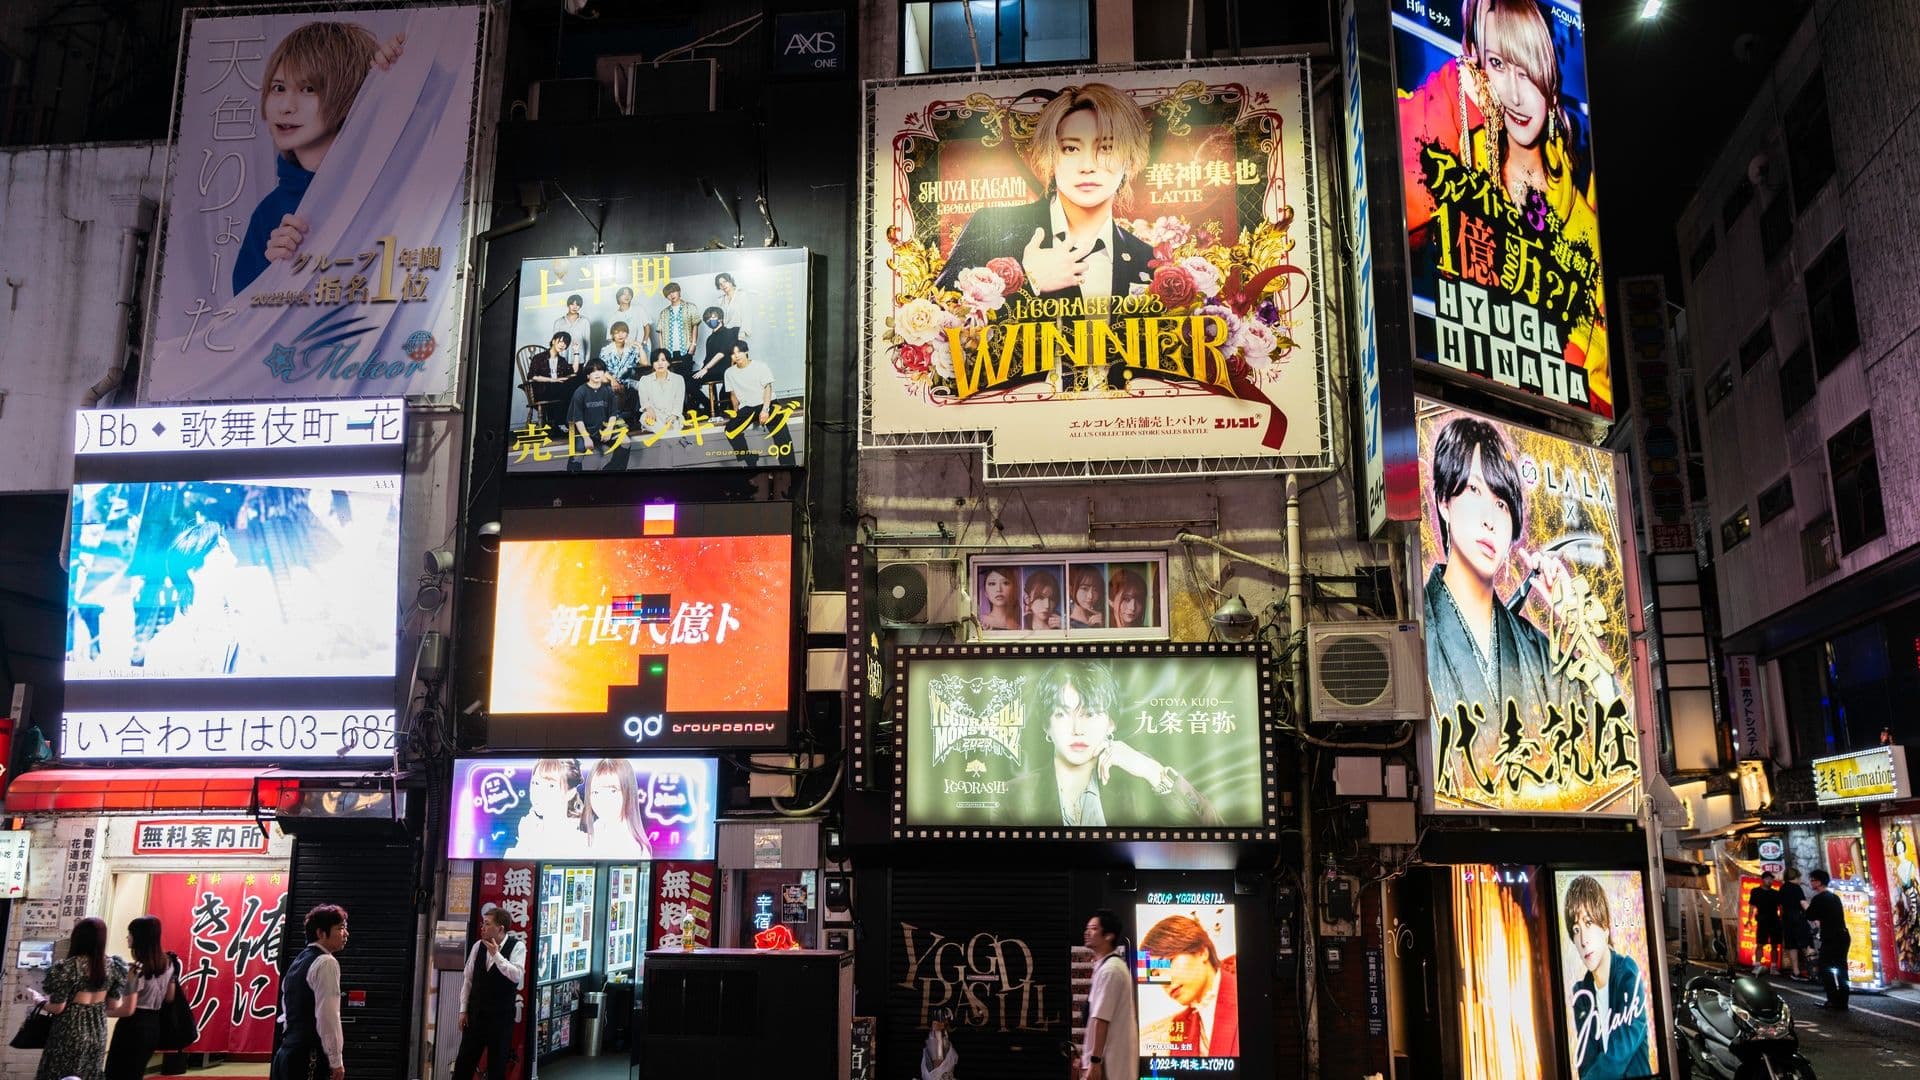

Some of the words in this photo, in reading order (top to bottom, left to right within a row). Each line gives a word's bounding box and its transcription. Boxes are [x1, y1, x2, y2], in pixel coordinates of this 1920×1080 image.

[784, 31, 836, 55] AXIS
[814, 59, 837, 69] ONE
[1145, 159, 1261, 190] 華神集也
[184, 33, 266, 355] 天色りょーた
[918, 180, 968, 203] SHUYA
[970, 175, 1026, 201] KAGAMI
[1150, 189, 1203, 204] LATTE
[1111, 294, 1166, 315] 2023
[1438, 278, 1562, 355] HYUGA
[945, 314, 1241, 400] WINNER
[1436, 318, 1590, 405] HINATA
[181, 403, 339, 449] 歌舞伎町
[1150, 698, 1188, 707] OTOYA
[1191, 698, 1219, 708] KUJO
[623, 714, 663, 742] gd
[1436, 694, 1640, 798] 代表就任
[1839, 764, 1893, 791] Information
[142, 826, 263, 848] 無料案内所
